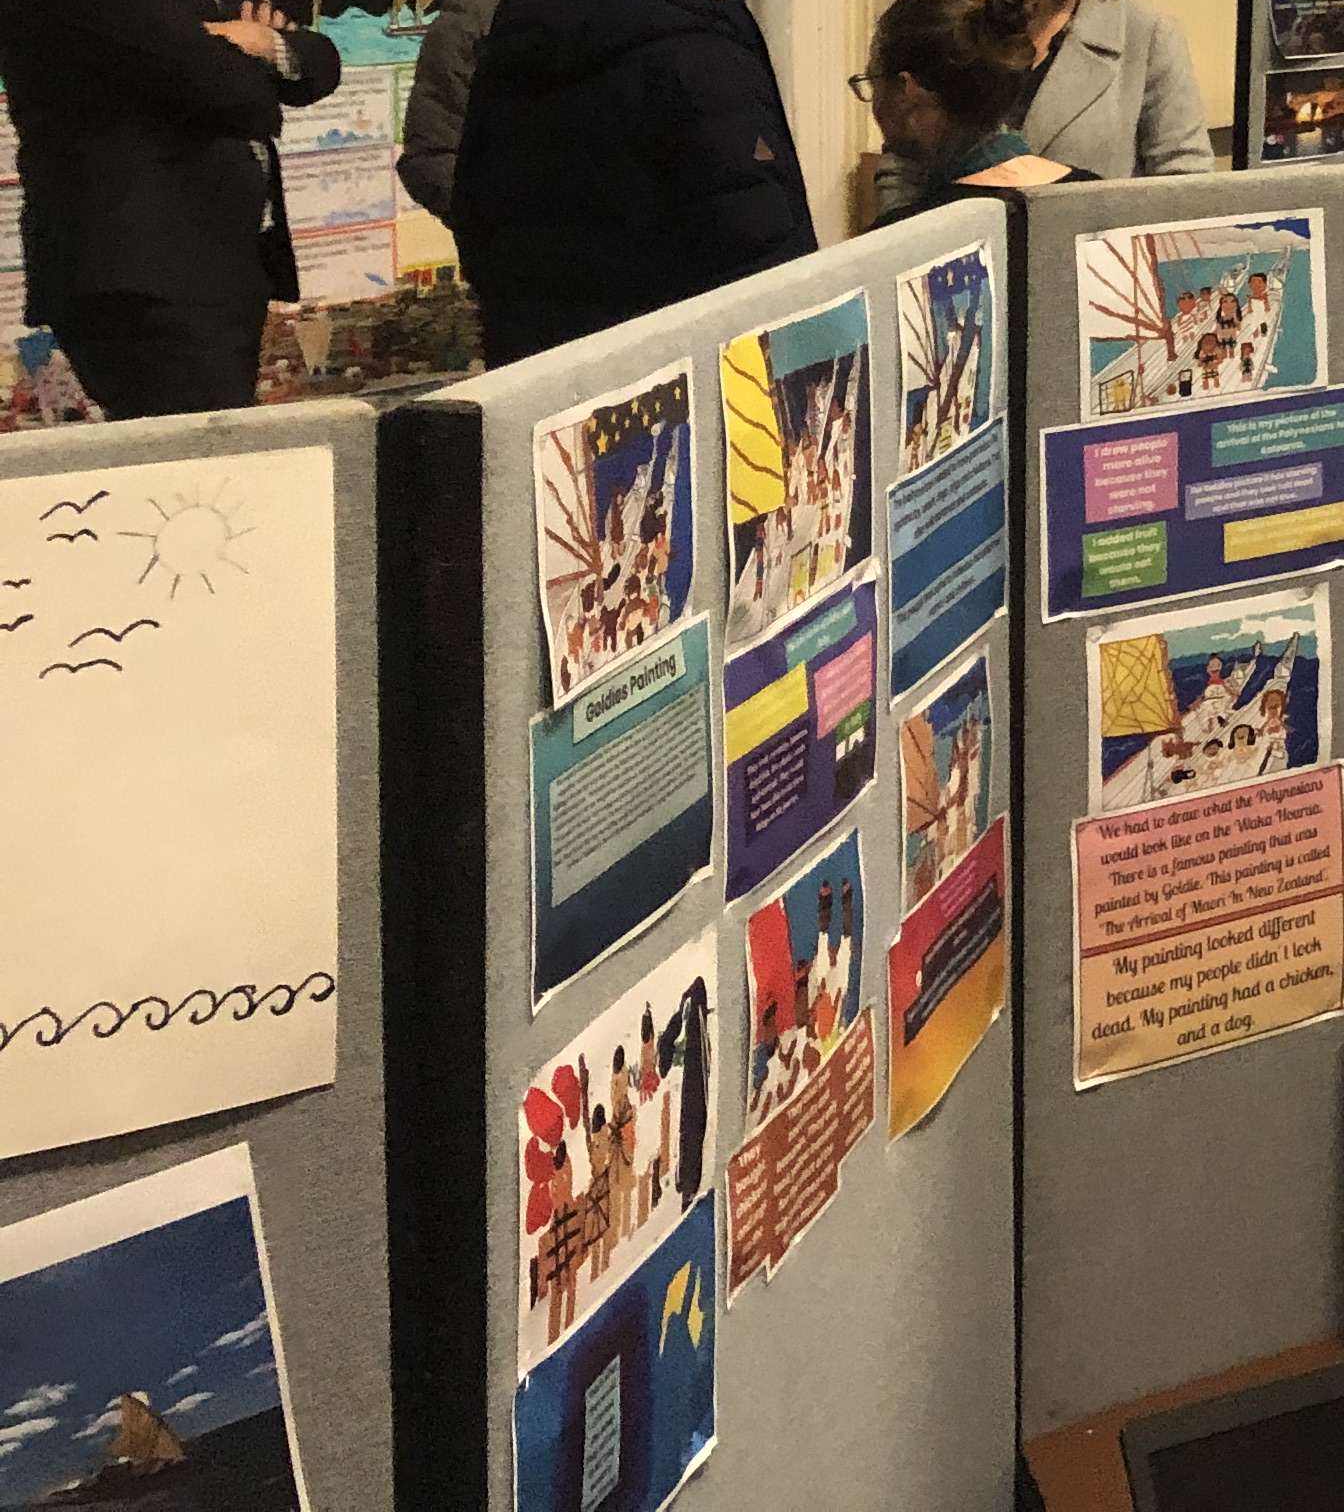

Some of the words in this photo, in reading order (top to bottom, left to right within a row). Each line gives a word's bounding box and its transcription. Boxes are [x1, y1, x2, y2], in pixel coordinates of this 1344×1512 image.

[585, 683, 628, 723] Goldies
[630, 654, 676, 695] Painting
[1097, 824, 1123, 840] We
[1124, 820, 1149, 836] had
[1153, 816, 1164, 830] to
[1168, 808, 1199, 827] draw
[1203, 801, 1232, 819] what
[1236, 796, 1253, 812] the
[1256, 780, 1323, 805] Polynesians
[1101, 845, 1139, 865] would
[1142, 838, 1167, 856] look
[1171, 832, 1192, 850] like
[1195, 831, 1210, 844] on
[1213, 822, 1231, 838] the
[1235, 815, 1272, 834] Waka
[1094, 892, 1141, 918] painted
[1145, 885, 1159, 906] by
[1206, 870, 1231, 886] This
[1235, 855, 1282, 882] painting
[1285, 852, 1295, 867] is
[1298, 845, 1330, 865] called
[1109, 867, 1144, 887] There
[1147, 864, 1157, 878] is
[1161, 865, 1169, 875] a
[1170, 851, 1215, 877] famous
[1219, 838, 1266, 864] painting
[1269, 832, 1292, 849] that
[1295, 827, 1318, 843] was
[1128, 908, 1173, 931] Arrival
[1175, 904, 1188, 921] of
[1191, 897, 1226, 915] Maori
[1229, 892, 1243, 905] In
[1247, 883, 1274, 900] New
[1106, 982, 1166, 1008] because
[1170, 974, 1193, 993] my
[1197, 961, 1242, 988] people
[1293, 937, 1322, 959] look
[1113, 955, 1138, 977] My
[1141, 940, 1203, 974] painting
[1207, 927, 1253, 951] looked
[1259, 909, 1316, 939] different
[1091, 1018, 1135, 1041] dead.
[1139, 1007, 1164, 1028] My
[1168, 991, 1228, 1024] painting
[1232, 980, 1261, 1001] had
[1265, 981, 1274, 993] a
[1177, 1025, 1206, 1046] and
[1211, 1024, 1220, 1036] a
[1224, 1013, 1254, 1036] dog.
